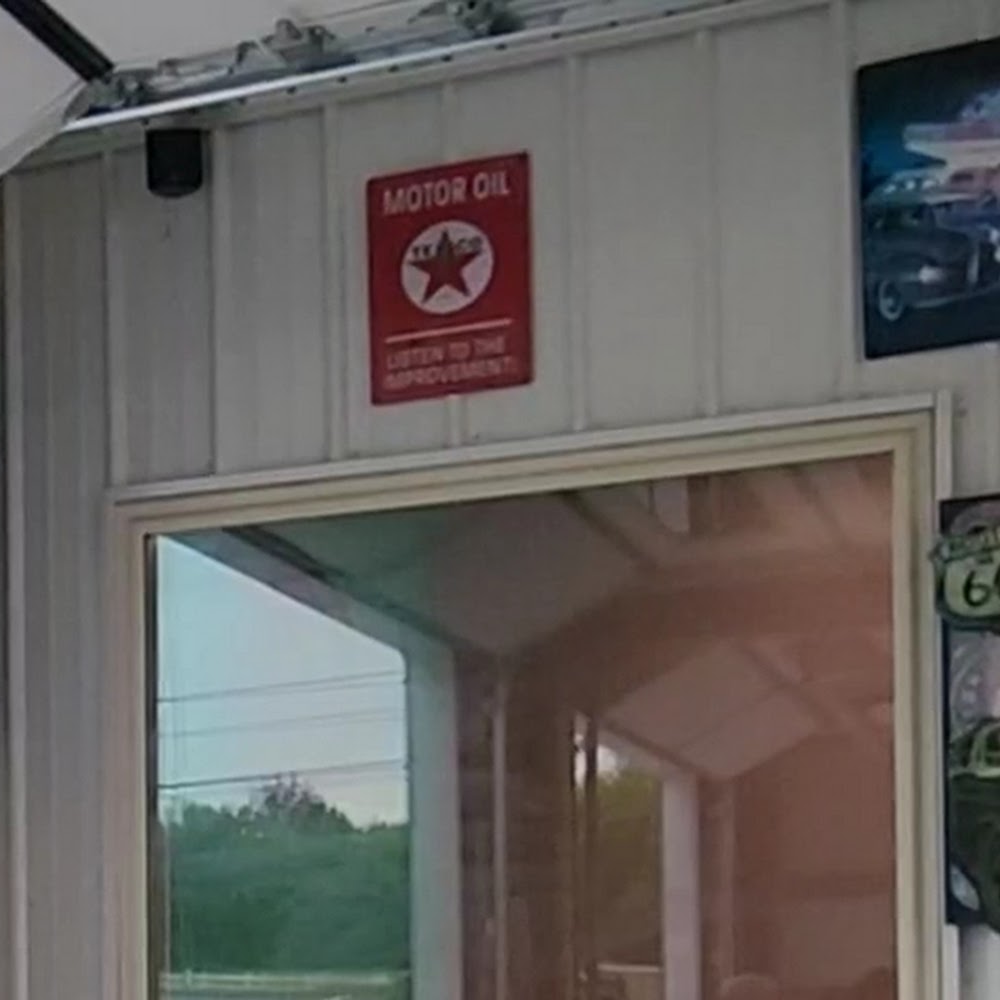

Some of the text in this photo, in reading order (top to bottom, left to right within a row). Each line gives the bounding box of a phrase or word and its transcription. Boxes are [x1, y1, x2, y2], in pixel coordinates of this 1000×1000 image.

[383, 171, 511, 215] MOTOR OIL
[386, 335, 505, 371] LISTEN TO THE
[963, 566, 1000, 608] 6
